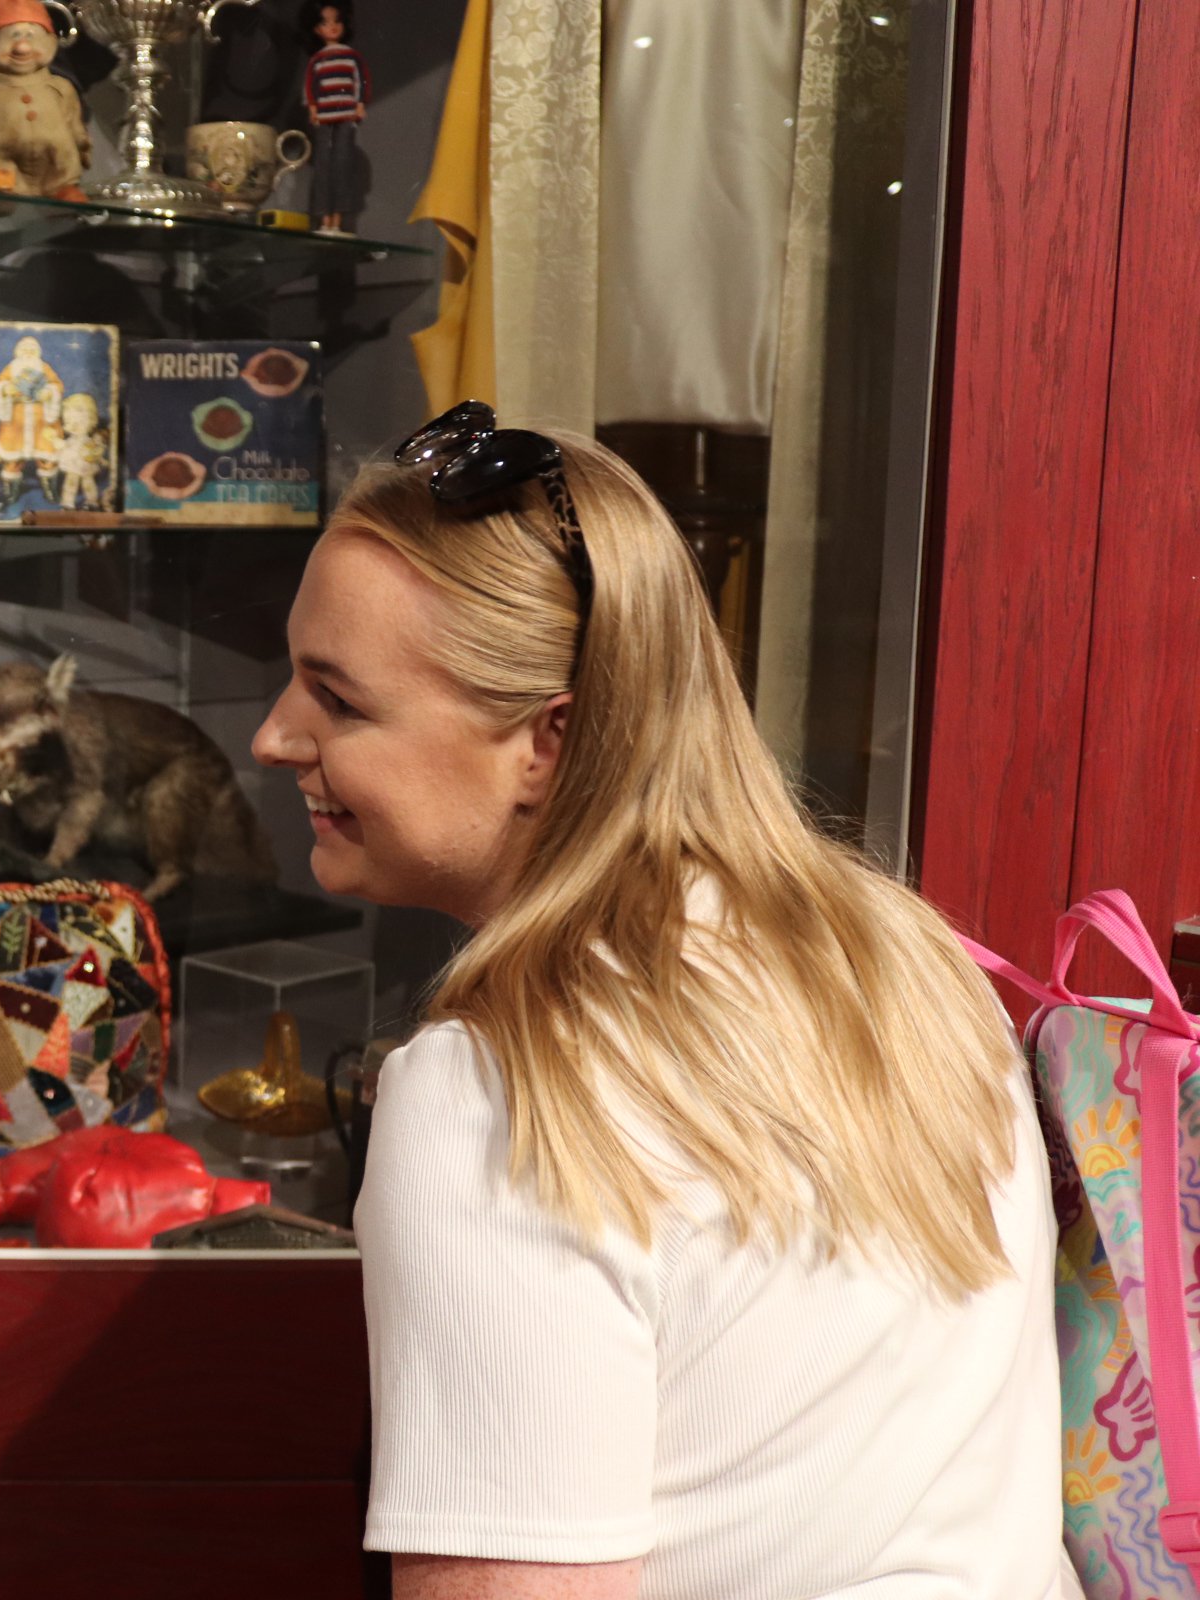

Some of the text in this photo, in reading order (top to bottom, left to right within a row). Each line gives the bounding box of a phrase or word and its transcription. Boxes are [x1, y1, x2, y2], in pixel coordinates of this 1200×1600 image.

[140, 353, 239, 379] WRIGHTS
[242, 450, 271, 464] Milk
[213, 456, 310, 480] Chocolate
[216, 484, 250, 503] TEA
